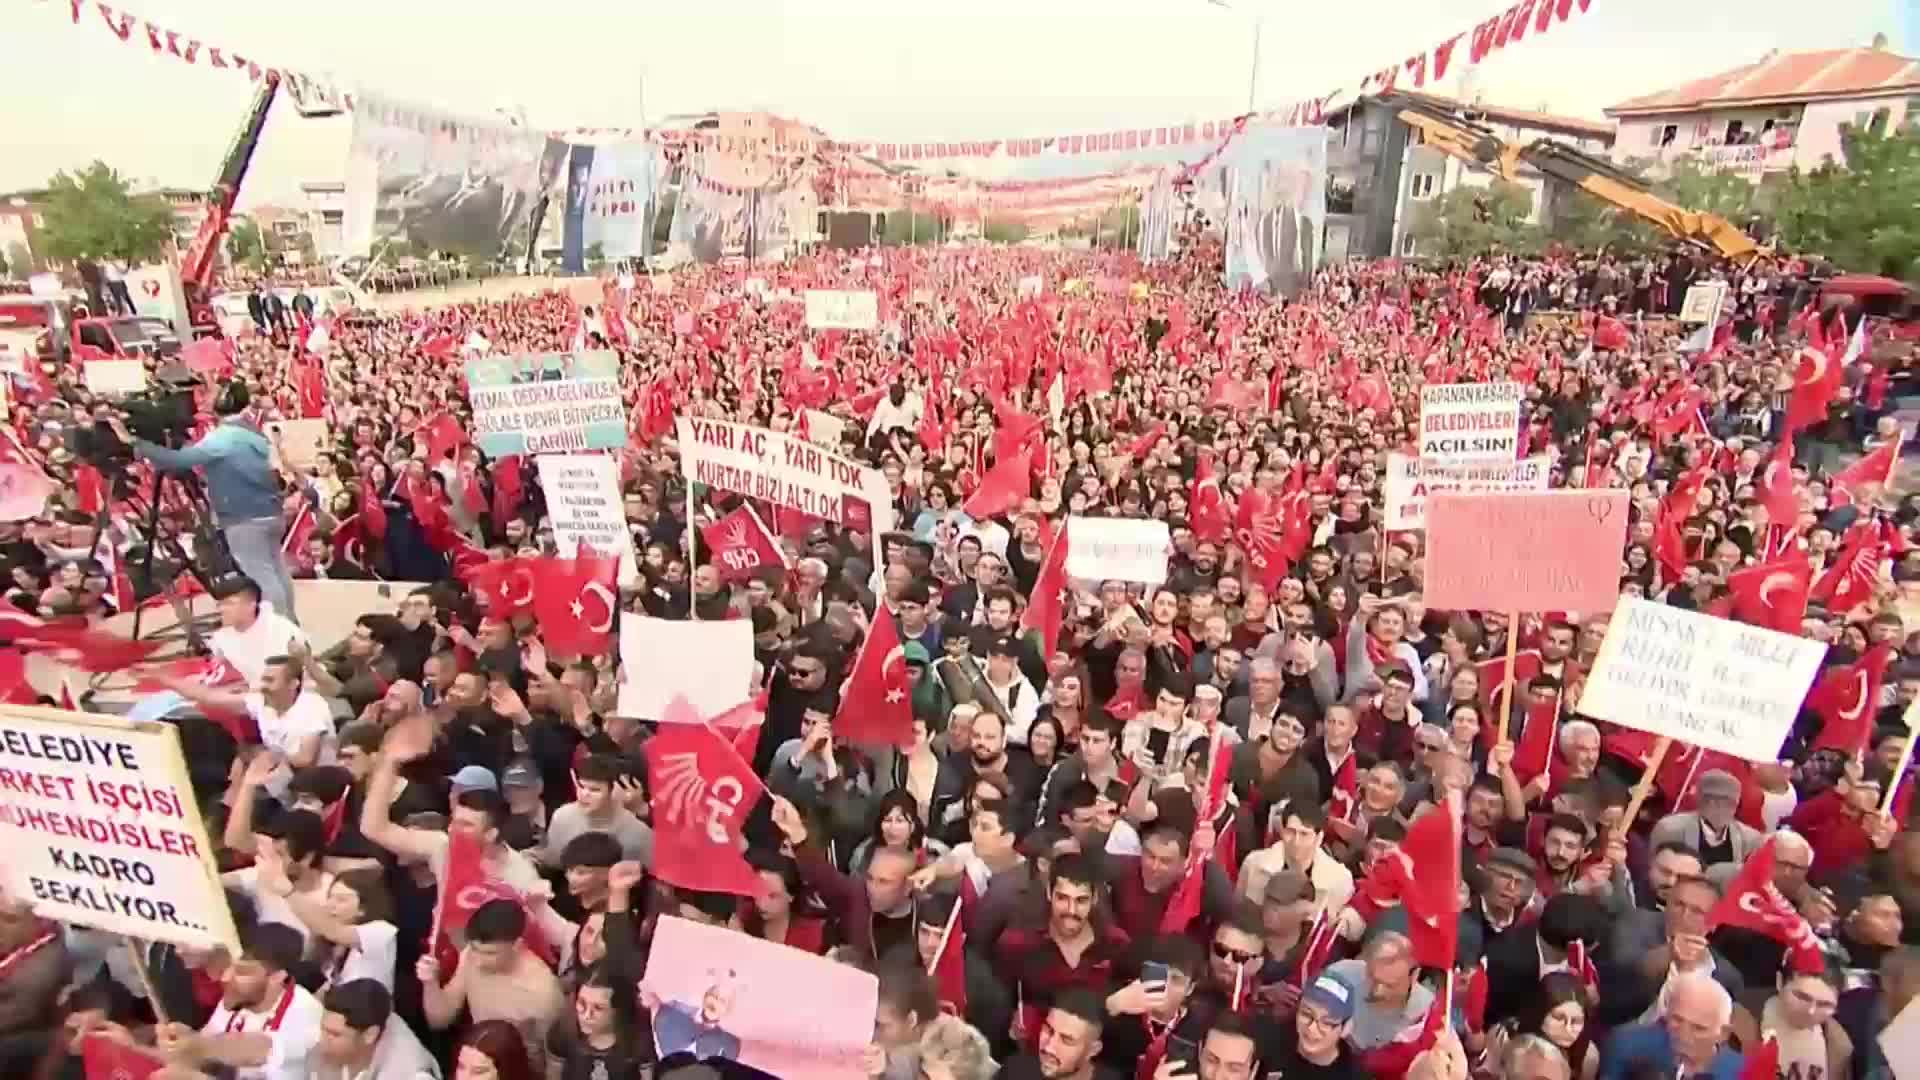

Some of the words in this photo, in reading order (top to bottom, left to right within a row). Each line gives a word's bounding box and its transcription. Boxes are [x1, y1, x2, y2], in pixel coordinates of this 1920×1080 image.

[690, 416, 734, 449] YARI
[784, 440, 821, 475] YARI
[828, 456, 863, 490] TOK
[696, 459, 751, 496] KURTAR
[820, 493, 840, 522] OK
[0, 729, 139, 770] ELEDİYE
[86, 773, 185, 819] İŞÇİSİ
[48, 846, 155, 886] KADRO
